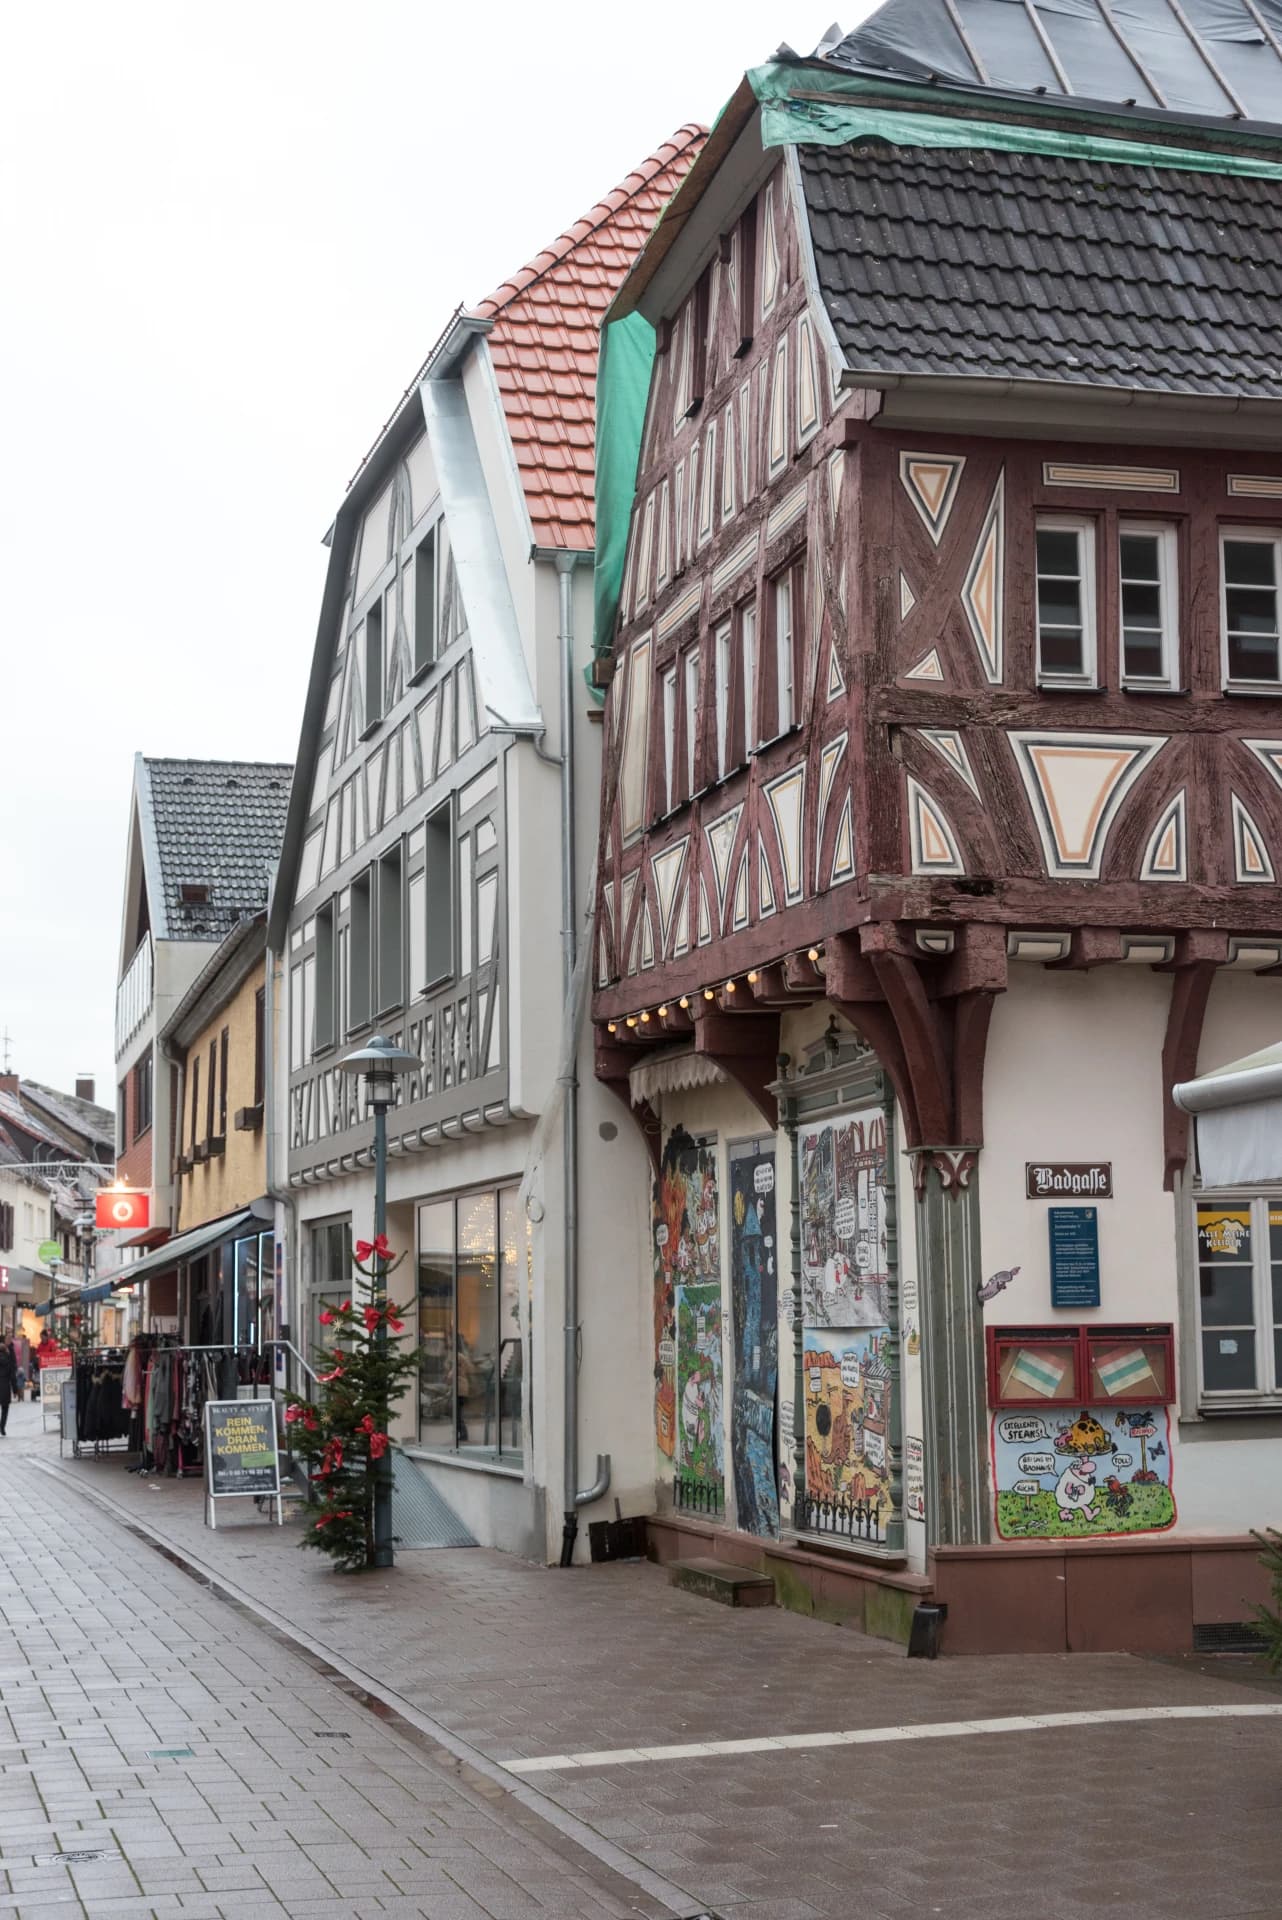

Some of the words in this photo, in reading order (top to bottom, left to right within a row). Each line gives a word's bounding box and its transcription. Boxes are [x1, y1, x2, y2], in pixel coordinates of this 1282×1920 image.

[1033, 1167, 1107, 1195] Badgasse
[1199, 1229, 1218, 1238] ALLE
[1223, 1230, 1250, 1238] MEINE
[1206, 1239, 1242, 1248] KLEIDER
[226, 1416, 252, 1426] REIN
[215, 1425, 267, 1437] KOMMEN,
[1007, 1429, 1043, 1440] STEAKS!
[227, 1435, 257, 1445] DRAN
[217, 1443, 269, 1455] KOMMEN.
